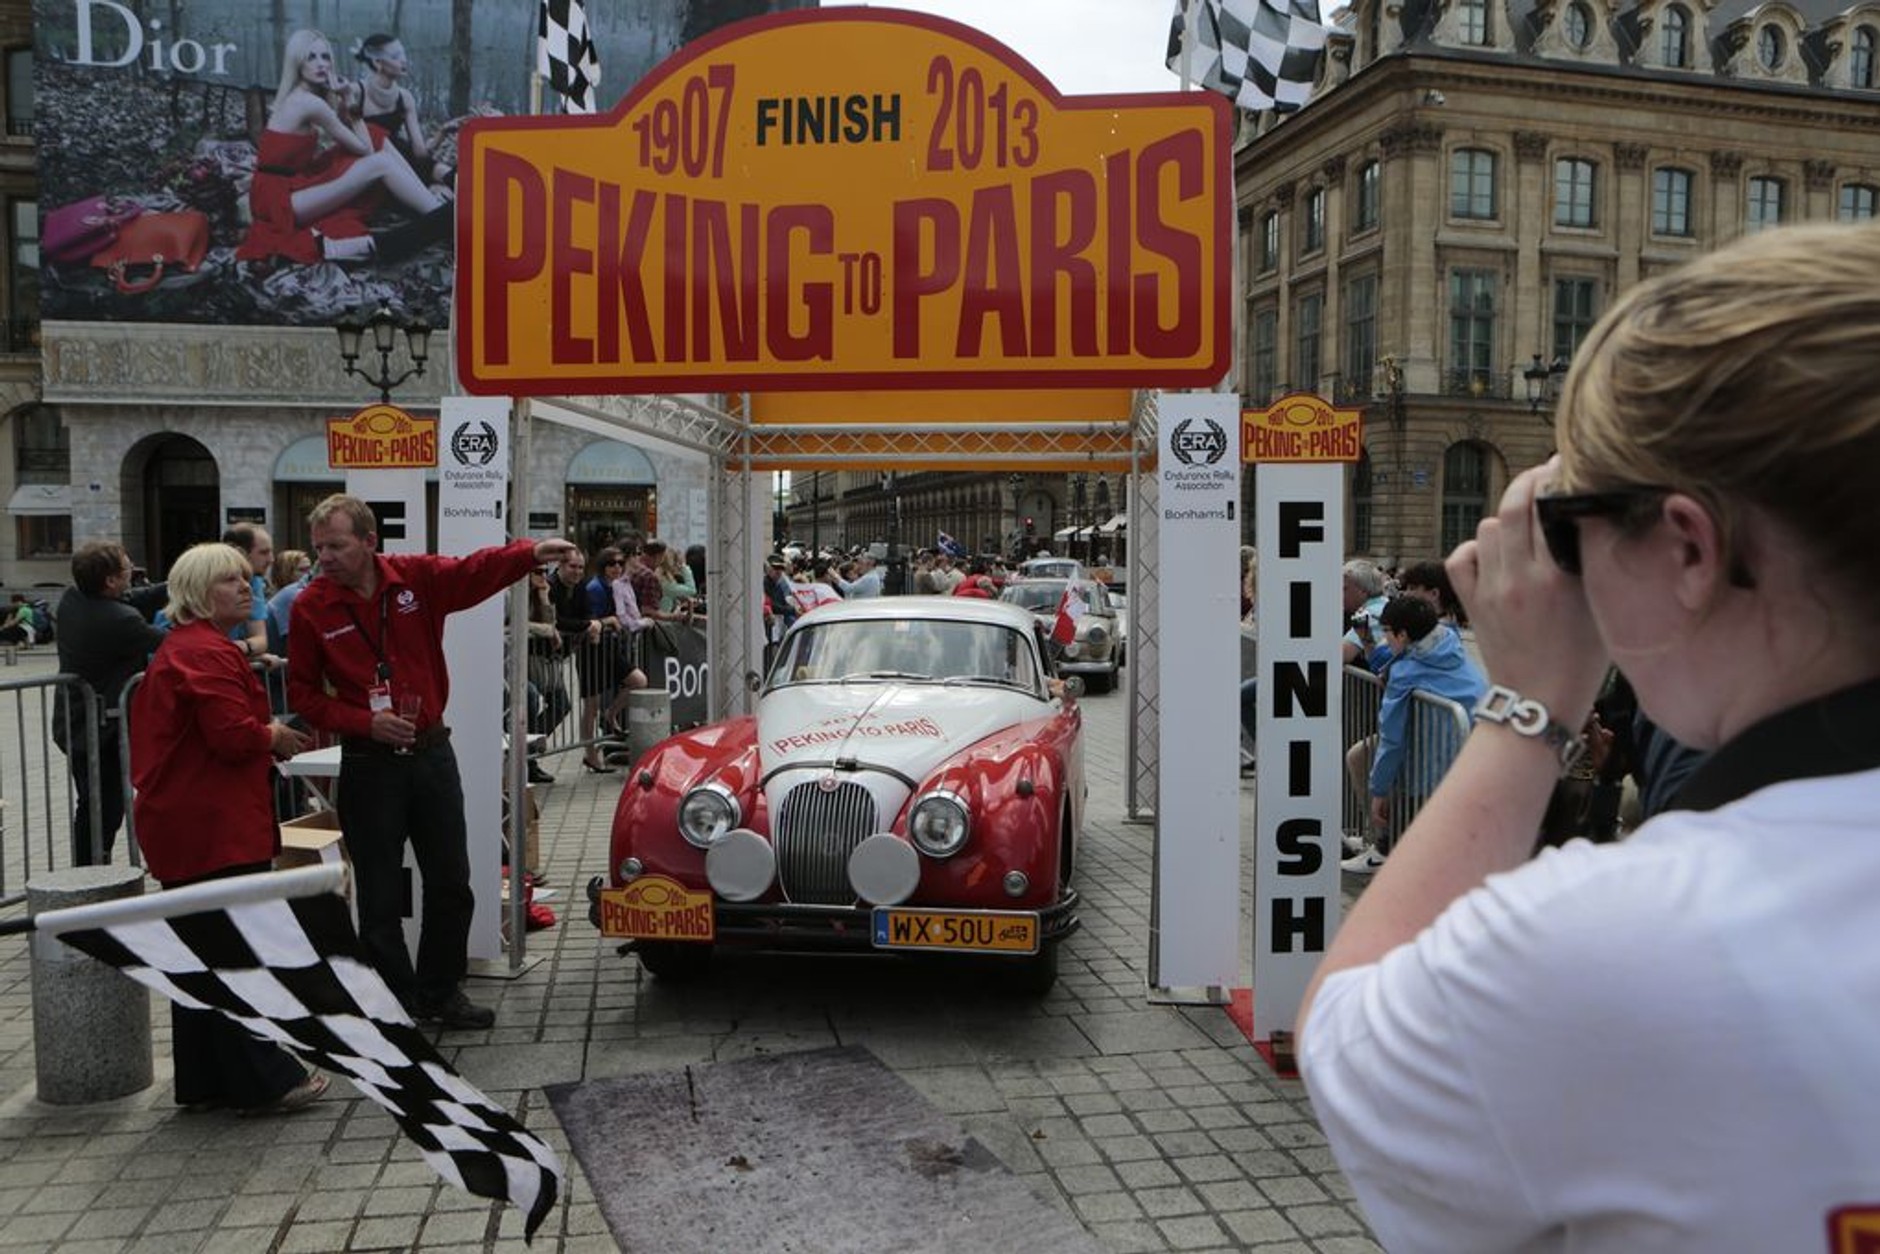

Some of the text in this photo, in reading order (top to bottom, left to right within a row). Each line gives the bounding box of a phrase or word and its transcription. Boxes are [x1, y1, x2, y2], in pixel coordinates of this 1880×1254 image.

[64, 0, 236, 75] Dior
[633, 54, 1040, 178] 1907 FINISH 2013
[483, 128, 1206, 367] PEKING TO PARIS
[332, 429, 433, 463] PEKING PARIS
[458, 436, 492, 452] ERA
[1179, 434, 1220, 450] ERA
[1244, 421, 1302, 457] PEKING
[1310, 421, 1357, 457] PARIS
[1174, 481, 1225, 490] Association
[444, 507, 493, 517] Bonhams
[1165, 509, 1225, 519] Bonhams
[884, 717, 940, 738] PARIS
[1271, 501, 1328, 953] FINISH
[603, 899, 710, 936] PEKING PARIS
[893, 916, 994, 945] WX 50U
